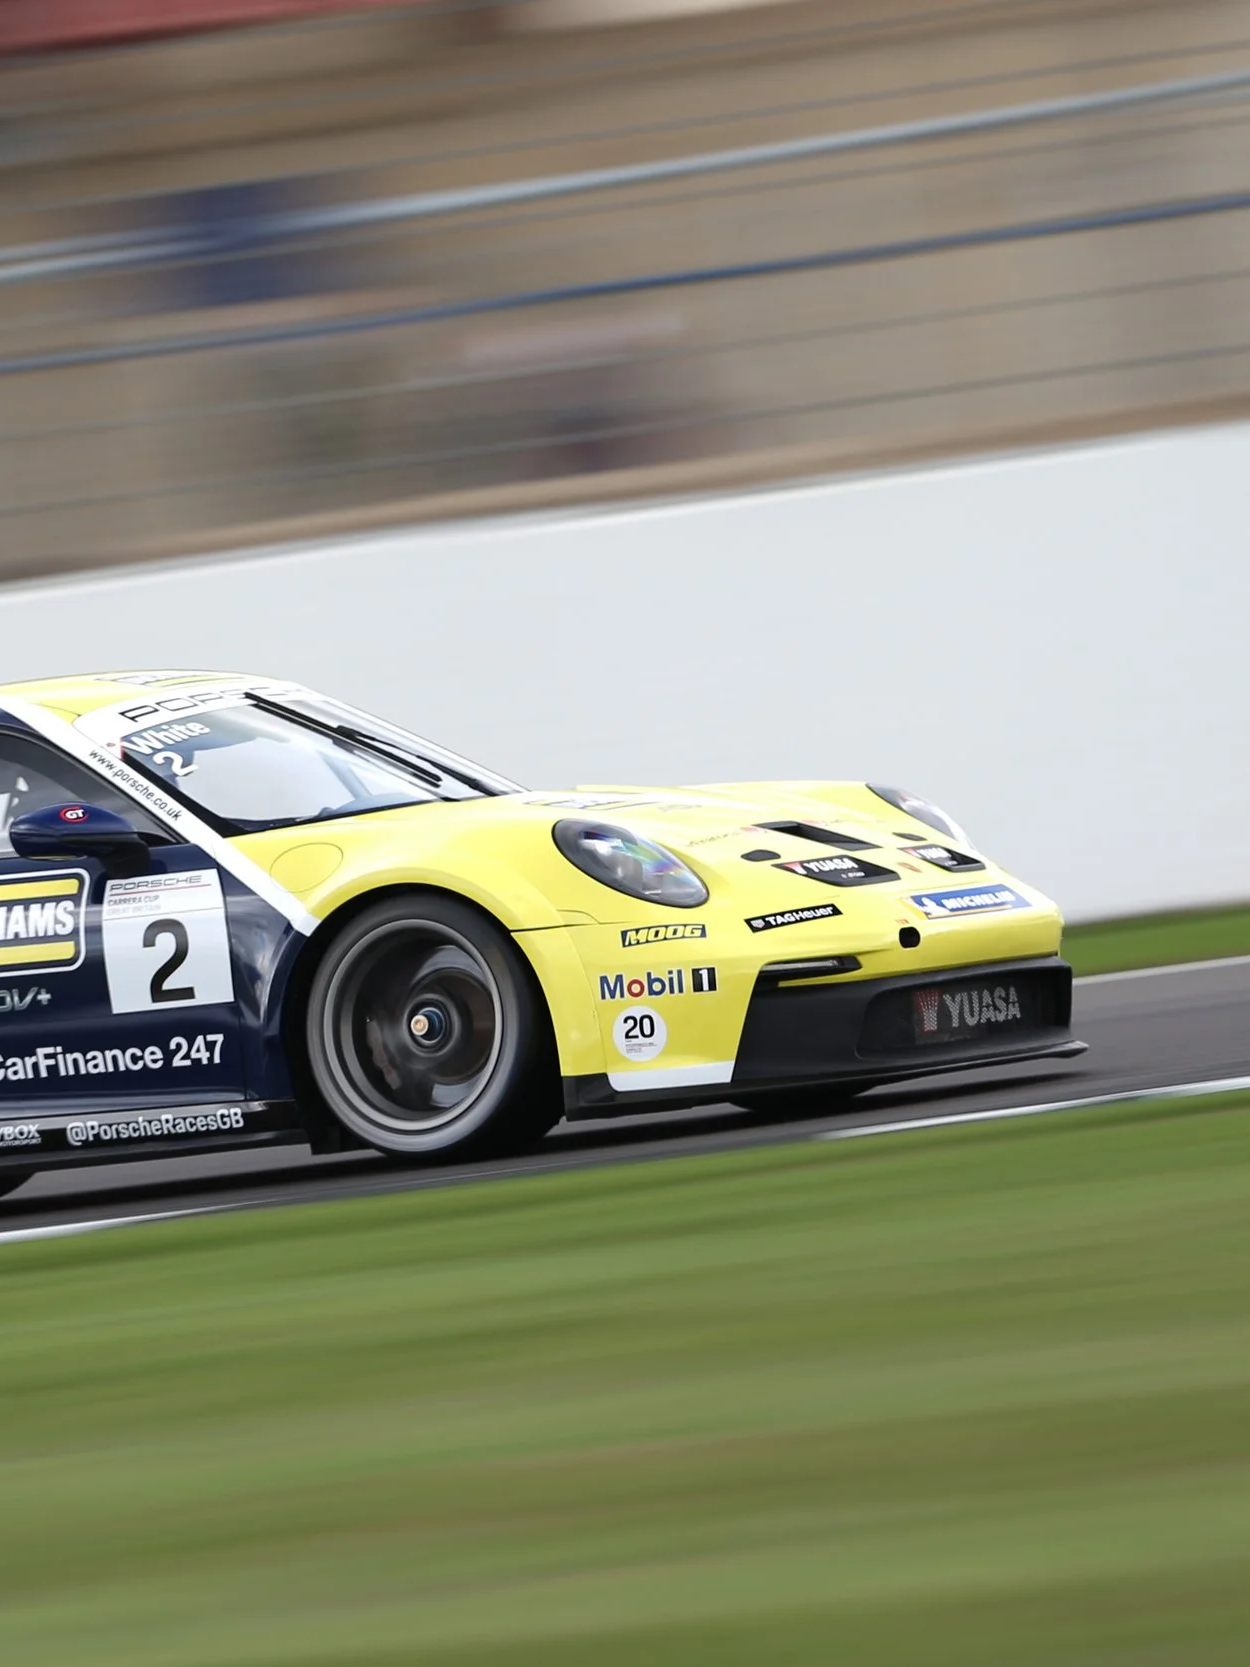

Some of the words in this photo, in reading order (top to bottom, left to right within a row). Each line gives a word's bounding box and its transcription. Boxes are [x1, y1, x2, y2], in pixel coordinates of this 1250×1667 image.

[122, 722, 211, 755] White
[153, 751, 200, 776] 2
[89, 749, 182, 821] www.porsche.co.uk
[65, 808, 85, 819] GT
[803, 857, 859, 873] YUASA
[110, 875, 203, 892] PORSCHE
[107, 896, 142, 907] CARRERA
[144, 894, 160, 904] CUP
[941, 890, 1016, 909] MICHELIN
[624, 924, 703, 946] MOOG
[142, 918, 196, 1003] 2
[600, 969, 684, 1000] Mobil
[699, 969, 709, 991] 1
[942, 986, 1021, 1027] YUASA
[623, 1014, 655, 1039] 20
[169, 1033, 225, 1067] 247
[66, 1108, 244, 1146] @PorscheRacesGB
